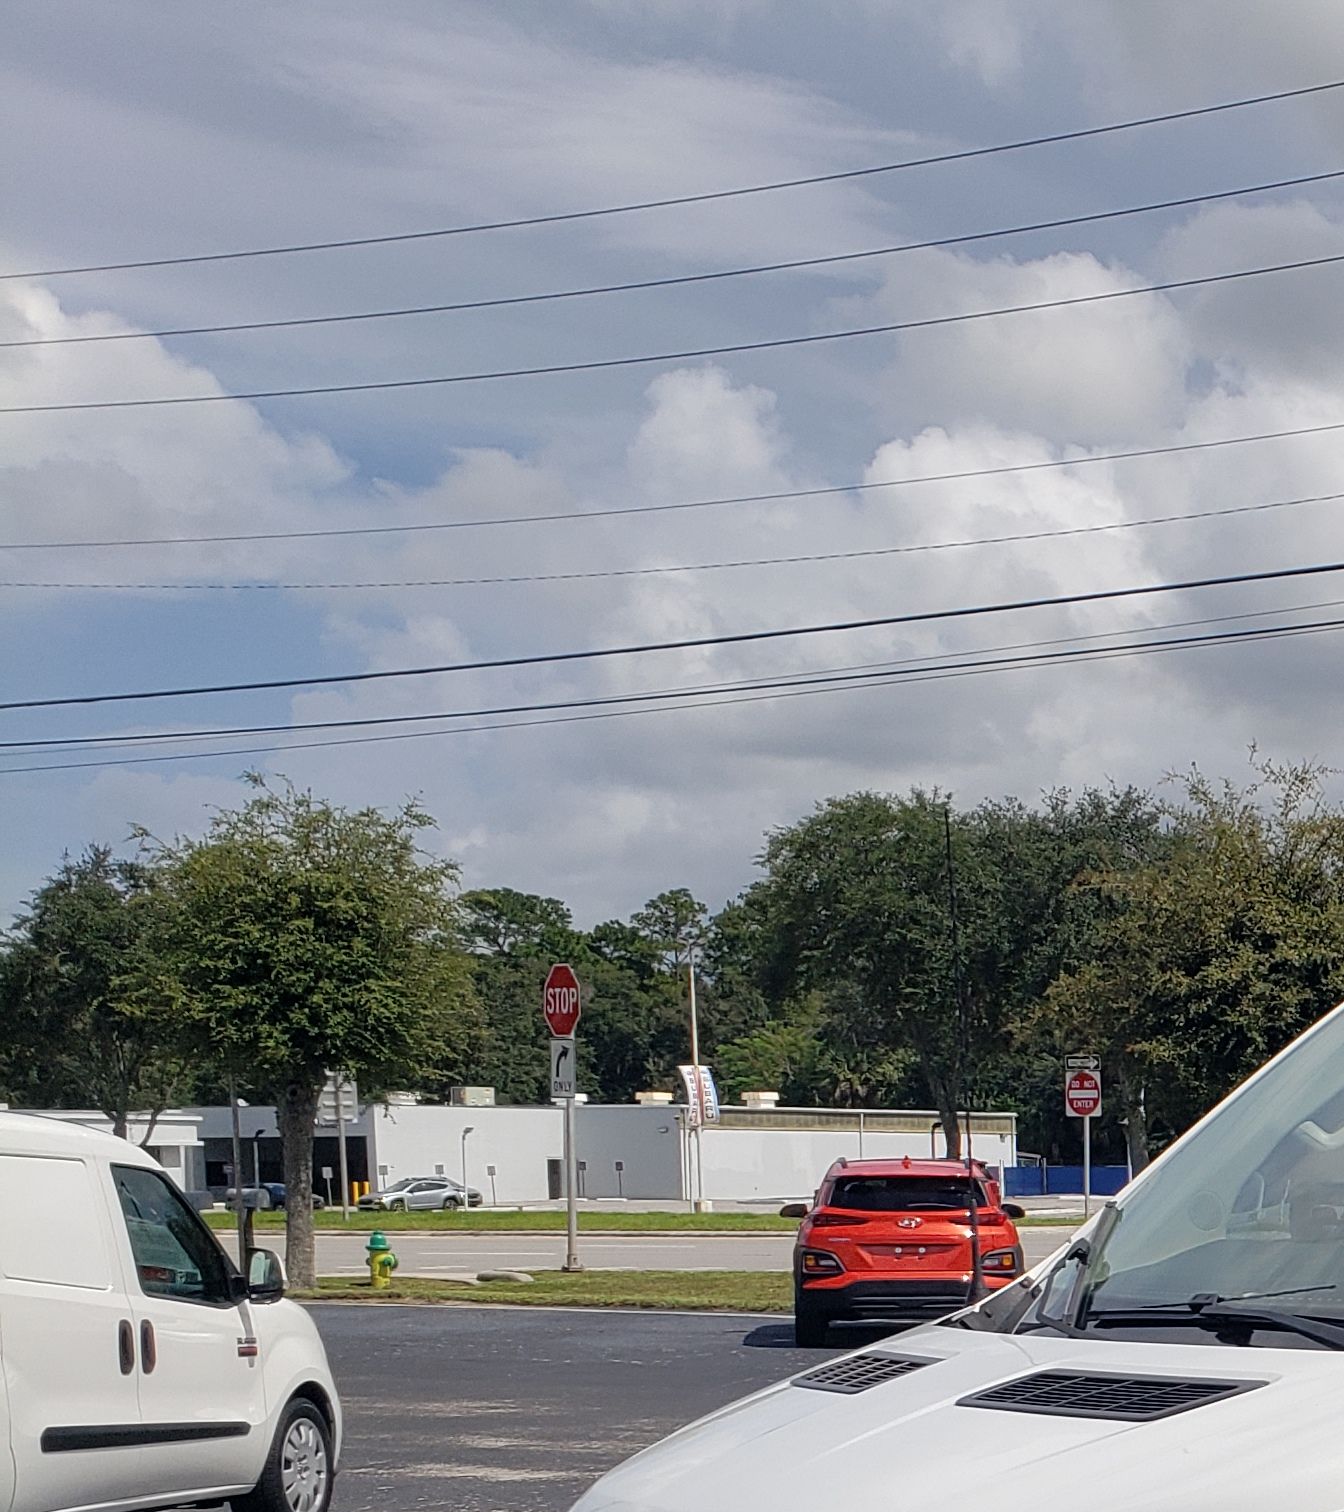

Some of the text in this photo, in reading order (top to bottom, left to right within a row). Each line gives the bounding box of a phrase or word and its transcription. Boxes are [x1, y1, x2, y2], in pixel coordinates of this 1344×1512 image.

[546, 987, 577, 1014] STOP
[553, 1081, 572, 1092] ONLY
[1071, 1080, 1095, 1088] DO NOT
[1073, 1100, 1094, 1108] ENTER
